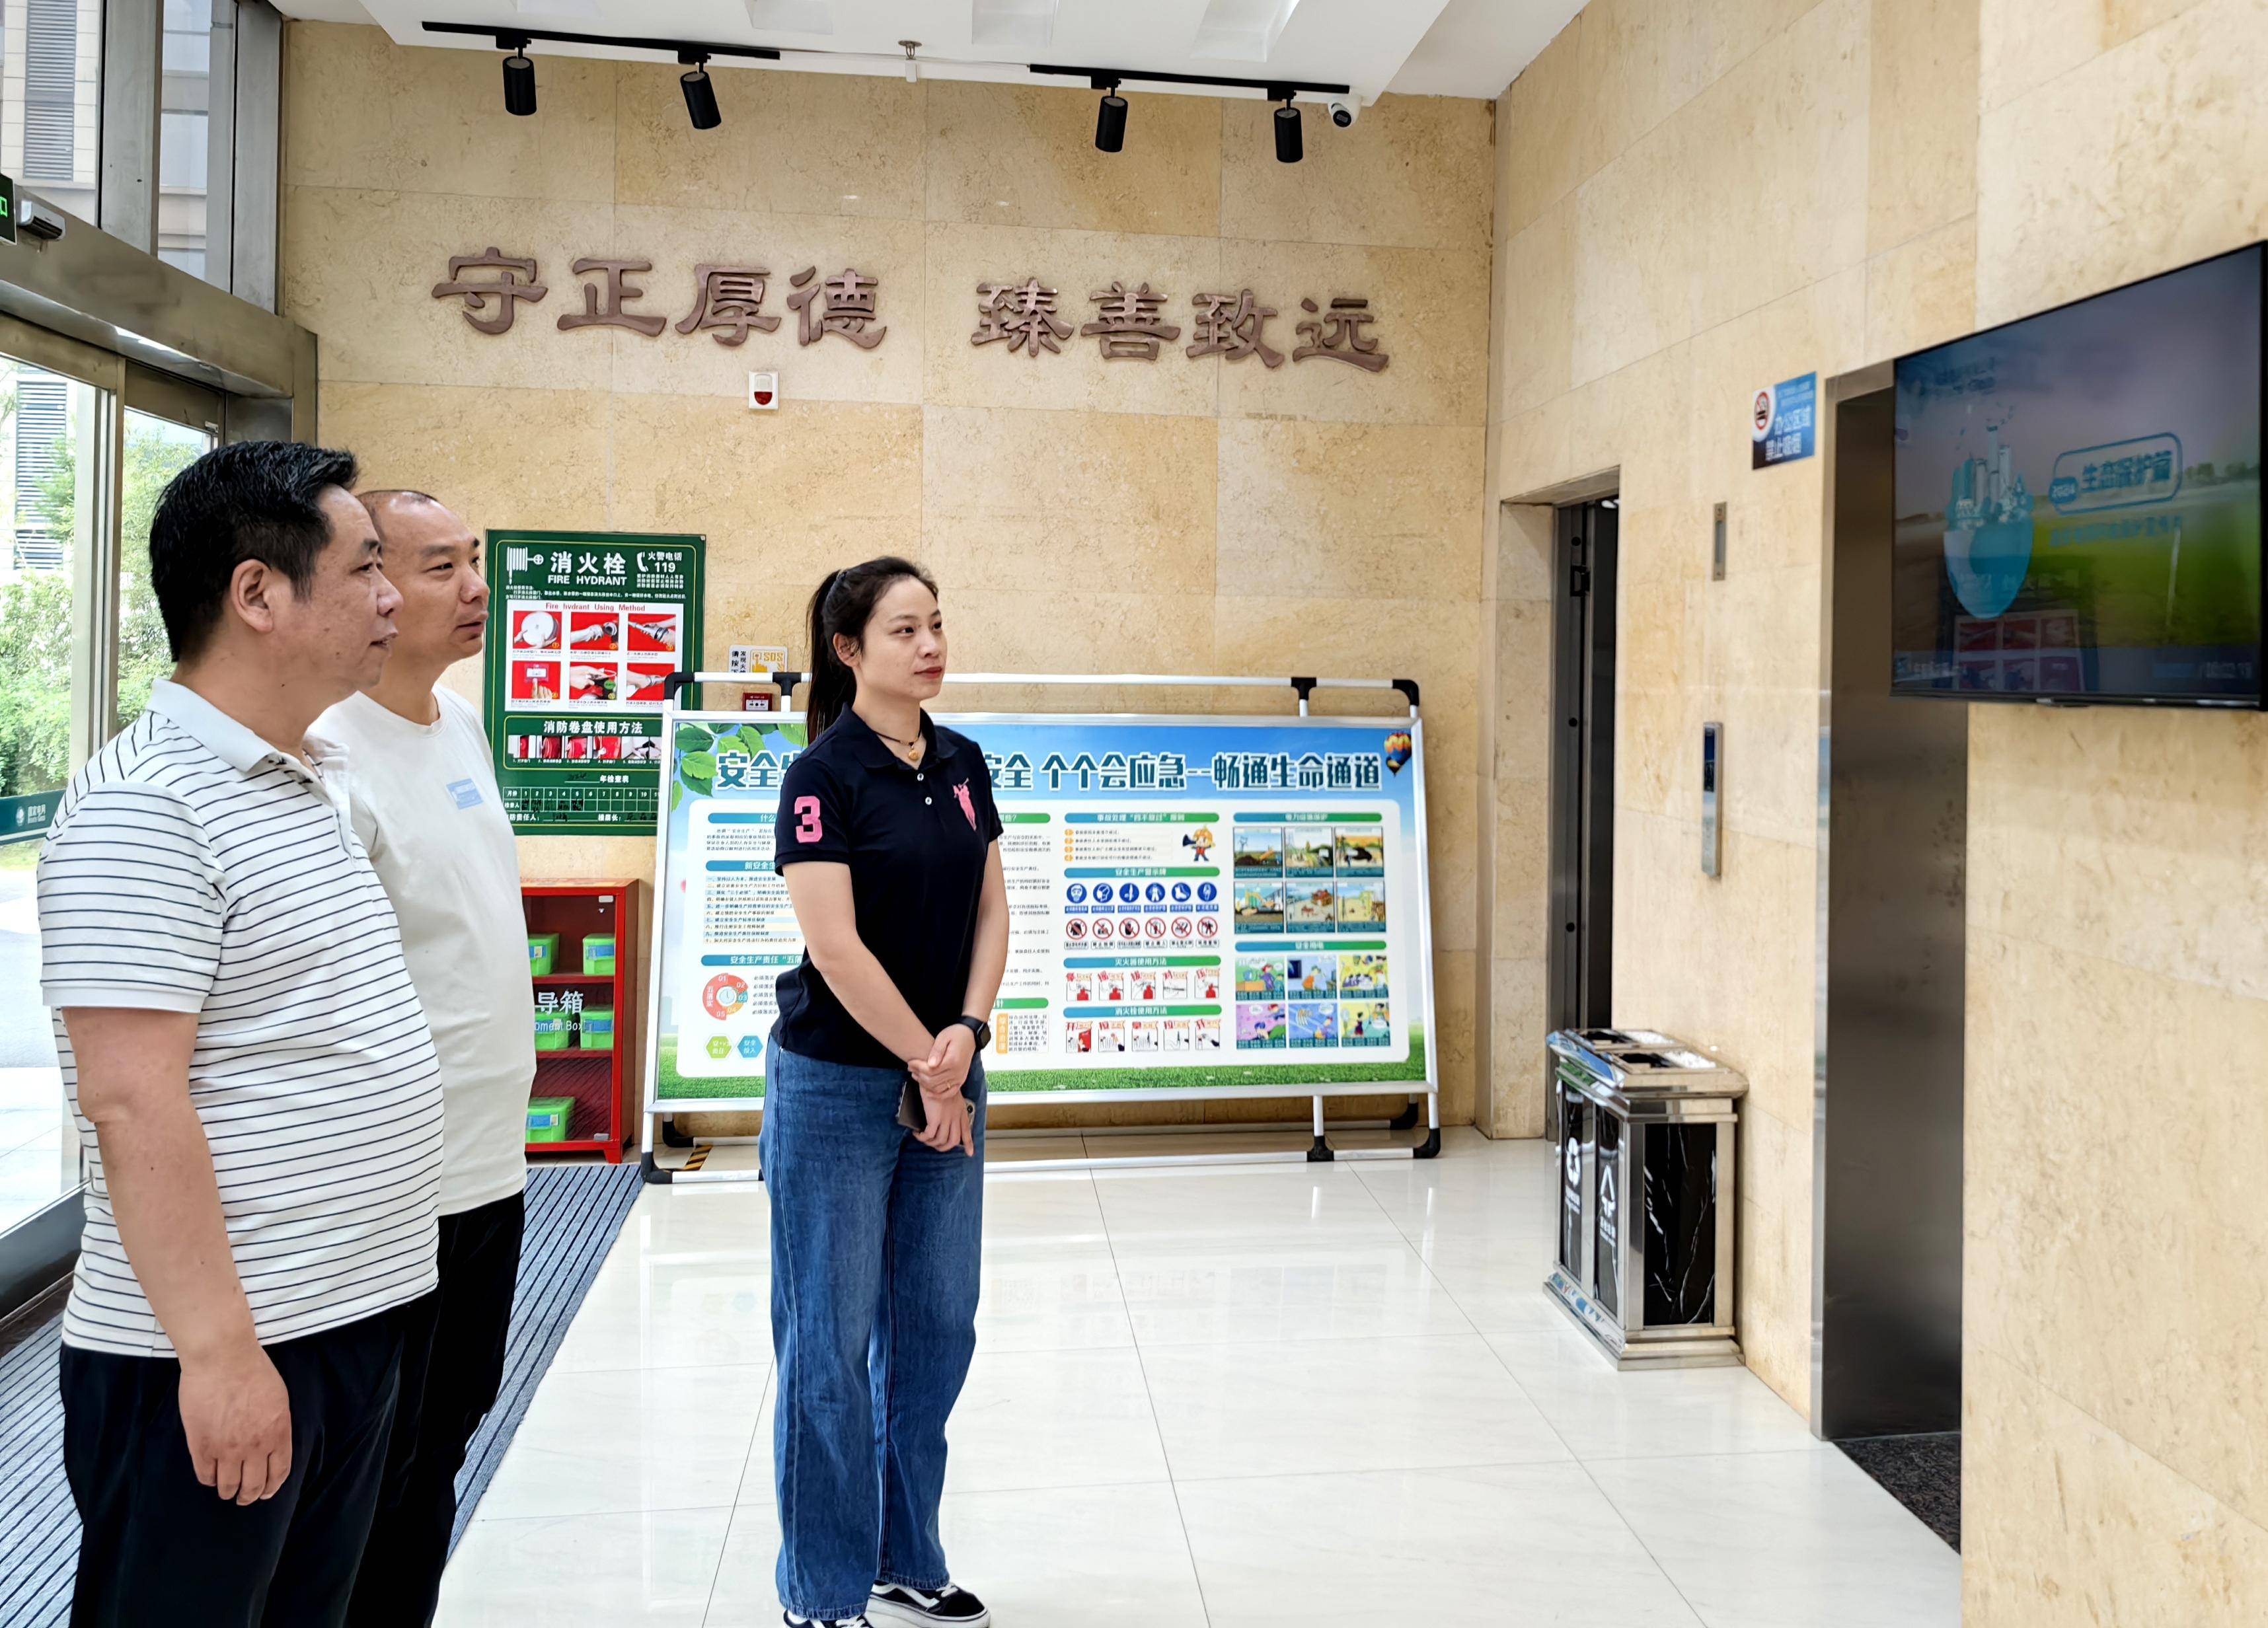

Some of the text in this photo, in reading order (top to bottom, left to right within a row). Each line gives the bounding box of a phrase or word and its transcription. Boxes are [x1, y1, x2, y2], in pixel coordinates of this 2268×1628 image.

[432, 246, 1389, 373] 守正厚德 臻善致远
[648, 552, 682, 561] 火警电话
[550, 551, 626, 575] 消火栓
[654, 562, 675, 573] 119
[548, 575, 570, 584] FIRE
[576, 576, 627, 585] HYDRANT
[764, 651, 783, 661] SOS
[544, 720, 643, 734] 消防卷盘使用方法
[600, 774, 629, 783] 年检查表
[794, 796, 823, 843] 3
[535, 990, 584, 1015] 导箱
[566, 1020, 583, 1031] Box
